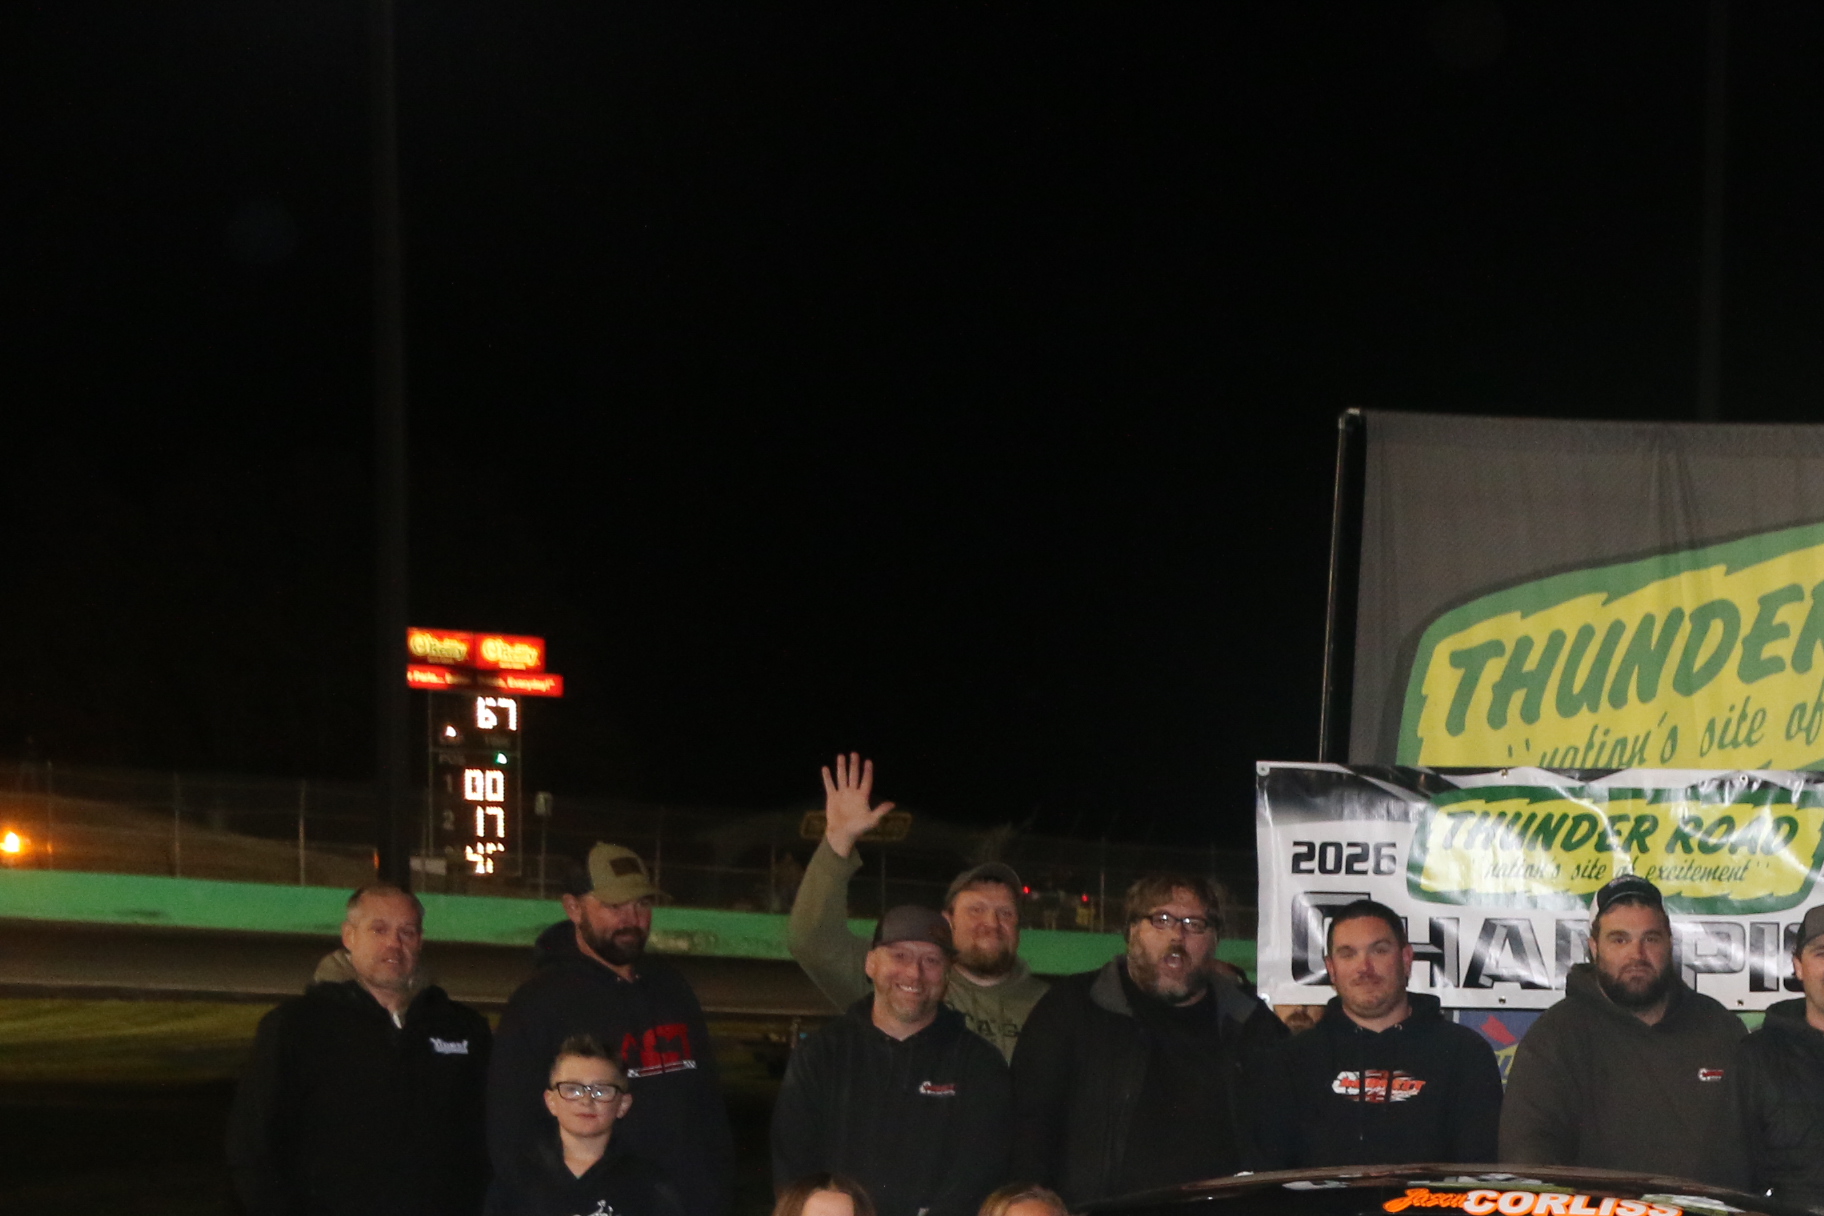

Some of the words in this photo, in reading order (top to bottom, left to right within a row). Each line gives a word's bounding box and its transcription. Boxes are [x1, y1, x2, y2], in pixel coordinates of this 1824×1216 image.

[476, 697, 517, 731] 67
[1700, 696, 1767, 757] site
[464, 769, 504, 801] 00
[476, 806, 505, 838] 17
[1446, 811, 1659, 854] THUNDER
[1666, 813, 1798, 857] ROAD
[1291, 841, 1397, 875] 2026
[1571, 856, 1606, 880] site
